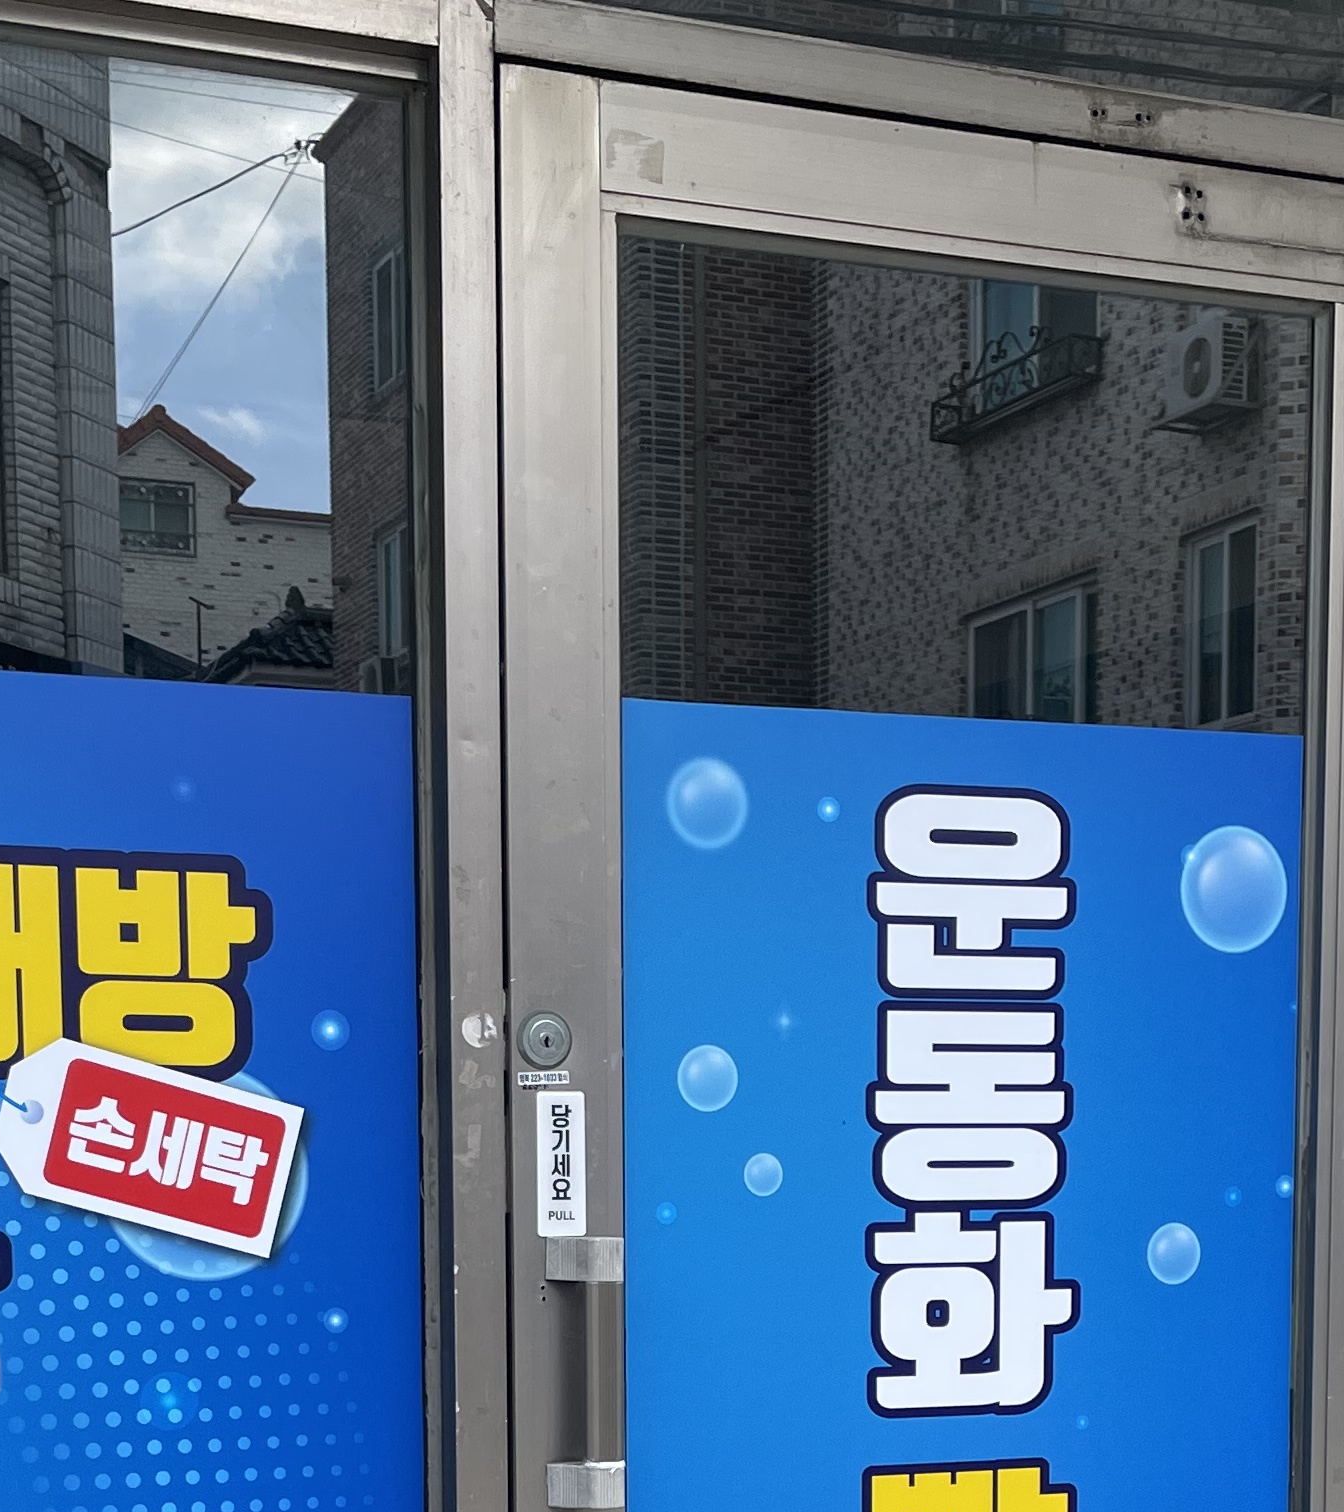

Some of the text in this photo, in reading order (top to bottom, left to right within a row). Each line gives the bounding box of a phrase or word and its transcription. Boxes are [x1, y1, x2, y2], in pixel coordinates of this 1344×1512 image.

[66, 1095, 269, 1207] 손세탁
[550, 1103, 573, 1201] 당기세요
[873, 792, 1073, 1410] 운동화
[548, 1210, 575, 1221] PULL
